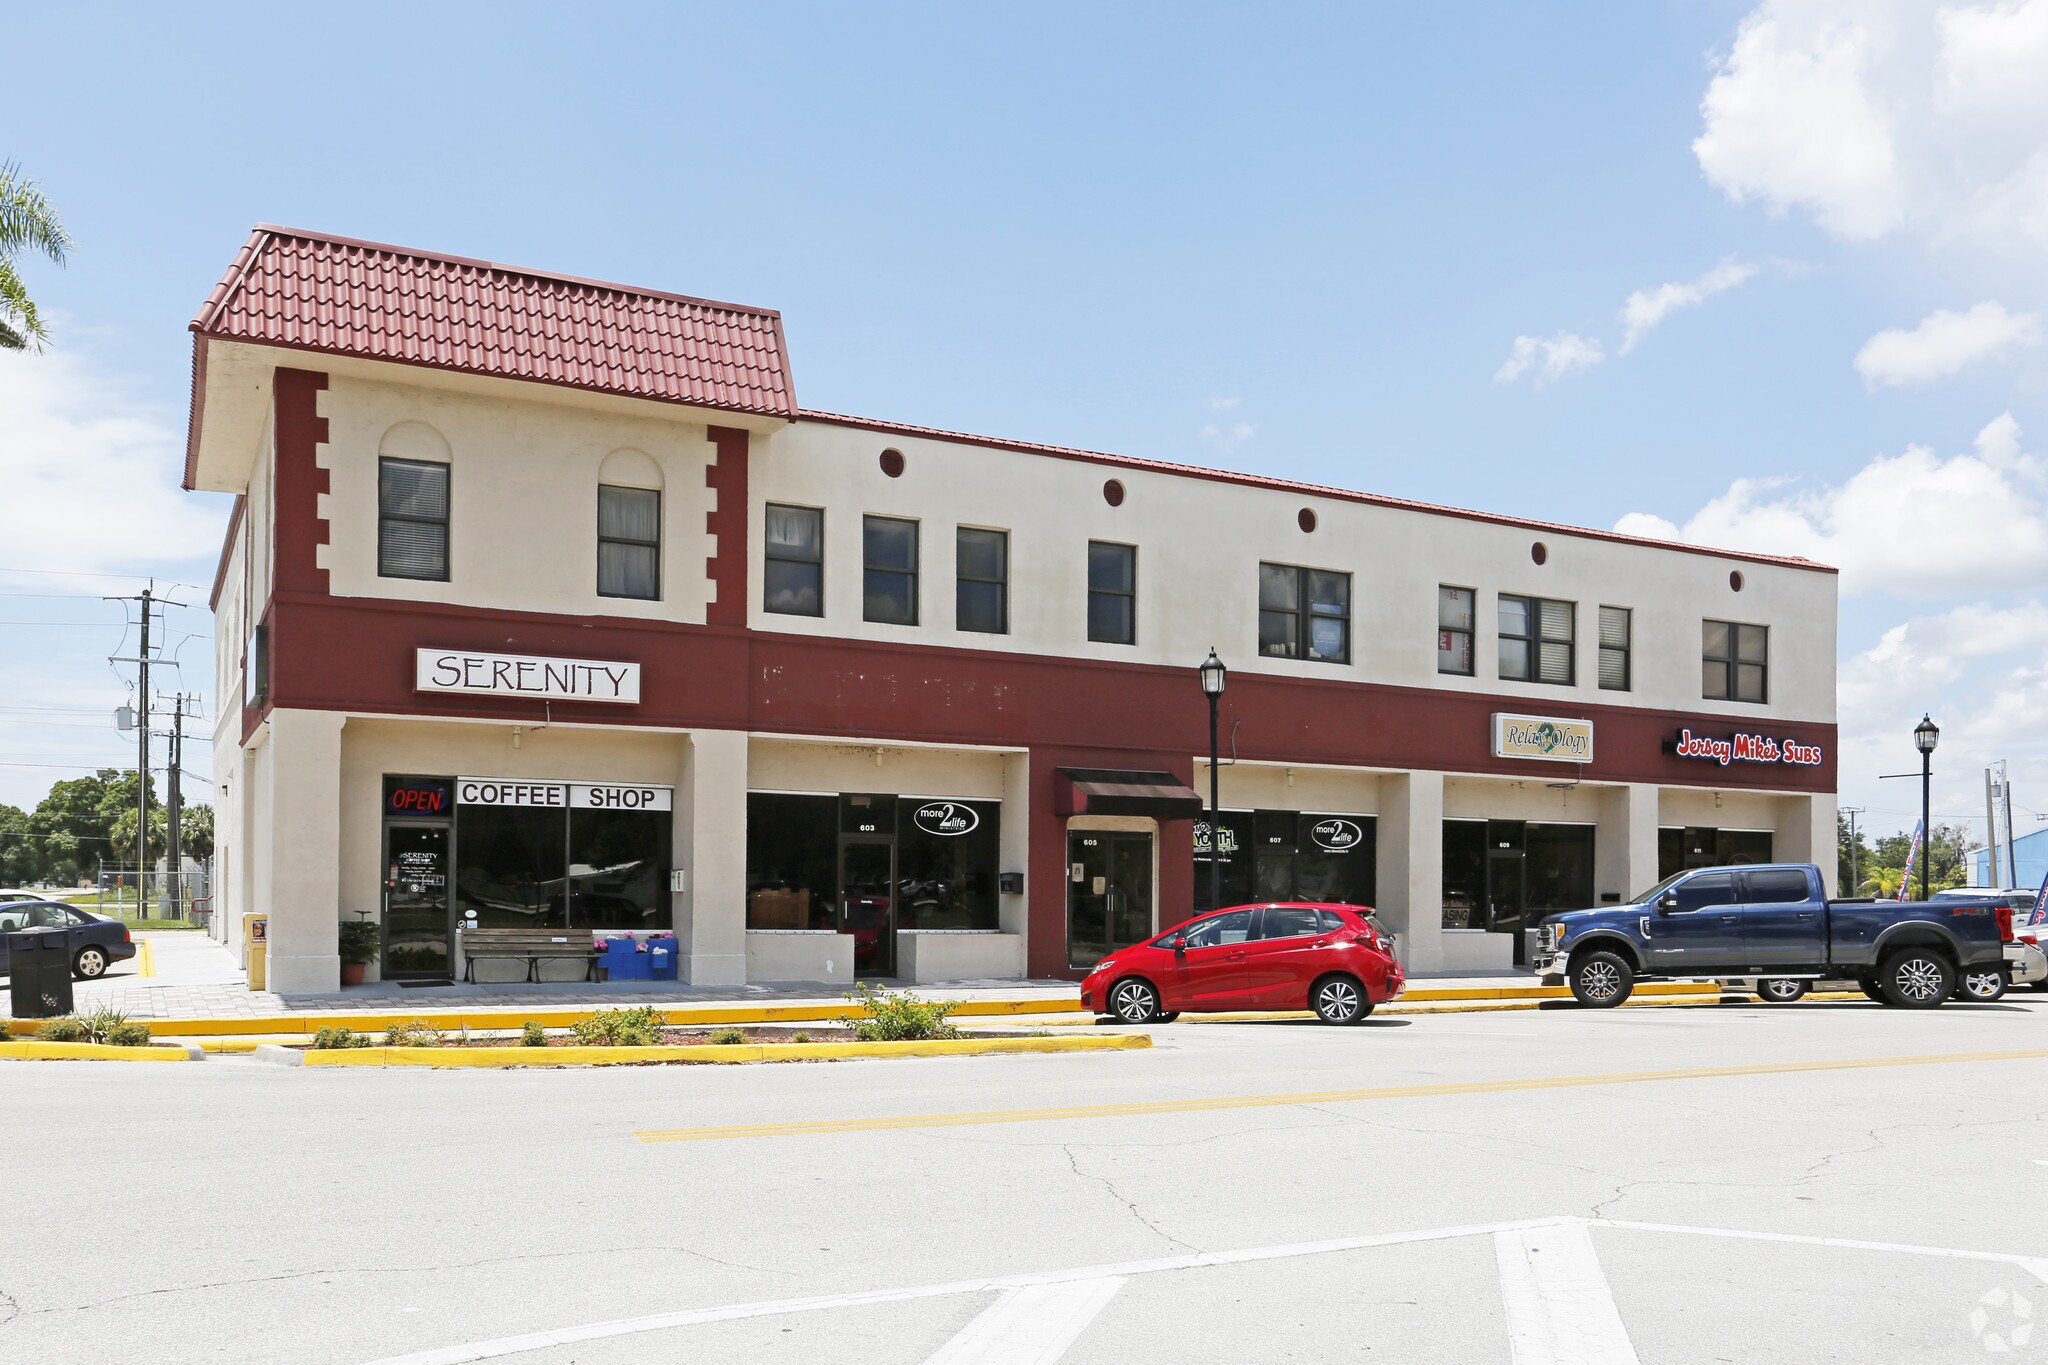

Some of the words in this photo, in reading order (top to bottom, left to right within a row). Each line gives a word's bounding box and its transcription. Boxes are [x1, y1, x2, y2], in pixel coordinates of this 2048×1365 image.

[431, 656, 628, 697] SERENITY
[1677, 729, 1730, 765] Jersey
[1733, 734, 1781, 762] Mike's
[392, 788, 442, 811] OPEN
[462, 783, 561, 806] COFFEE
[589, 787, 655, 808] SHOP
[920, 809, 944, 818] more
[939, 804, 954, 827] 2
[951, 817, 967, 828] life
[860, 824, 875, 832] 603
[1193, 830, 1234, 847] YOTH
[1316, 826, 1335, 834] more
[1331, 821, 1343, 842] 2
[1340, 832, 1353, 842] life
